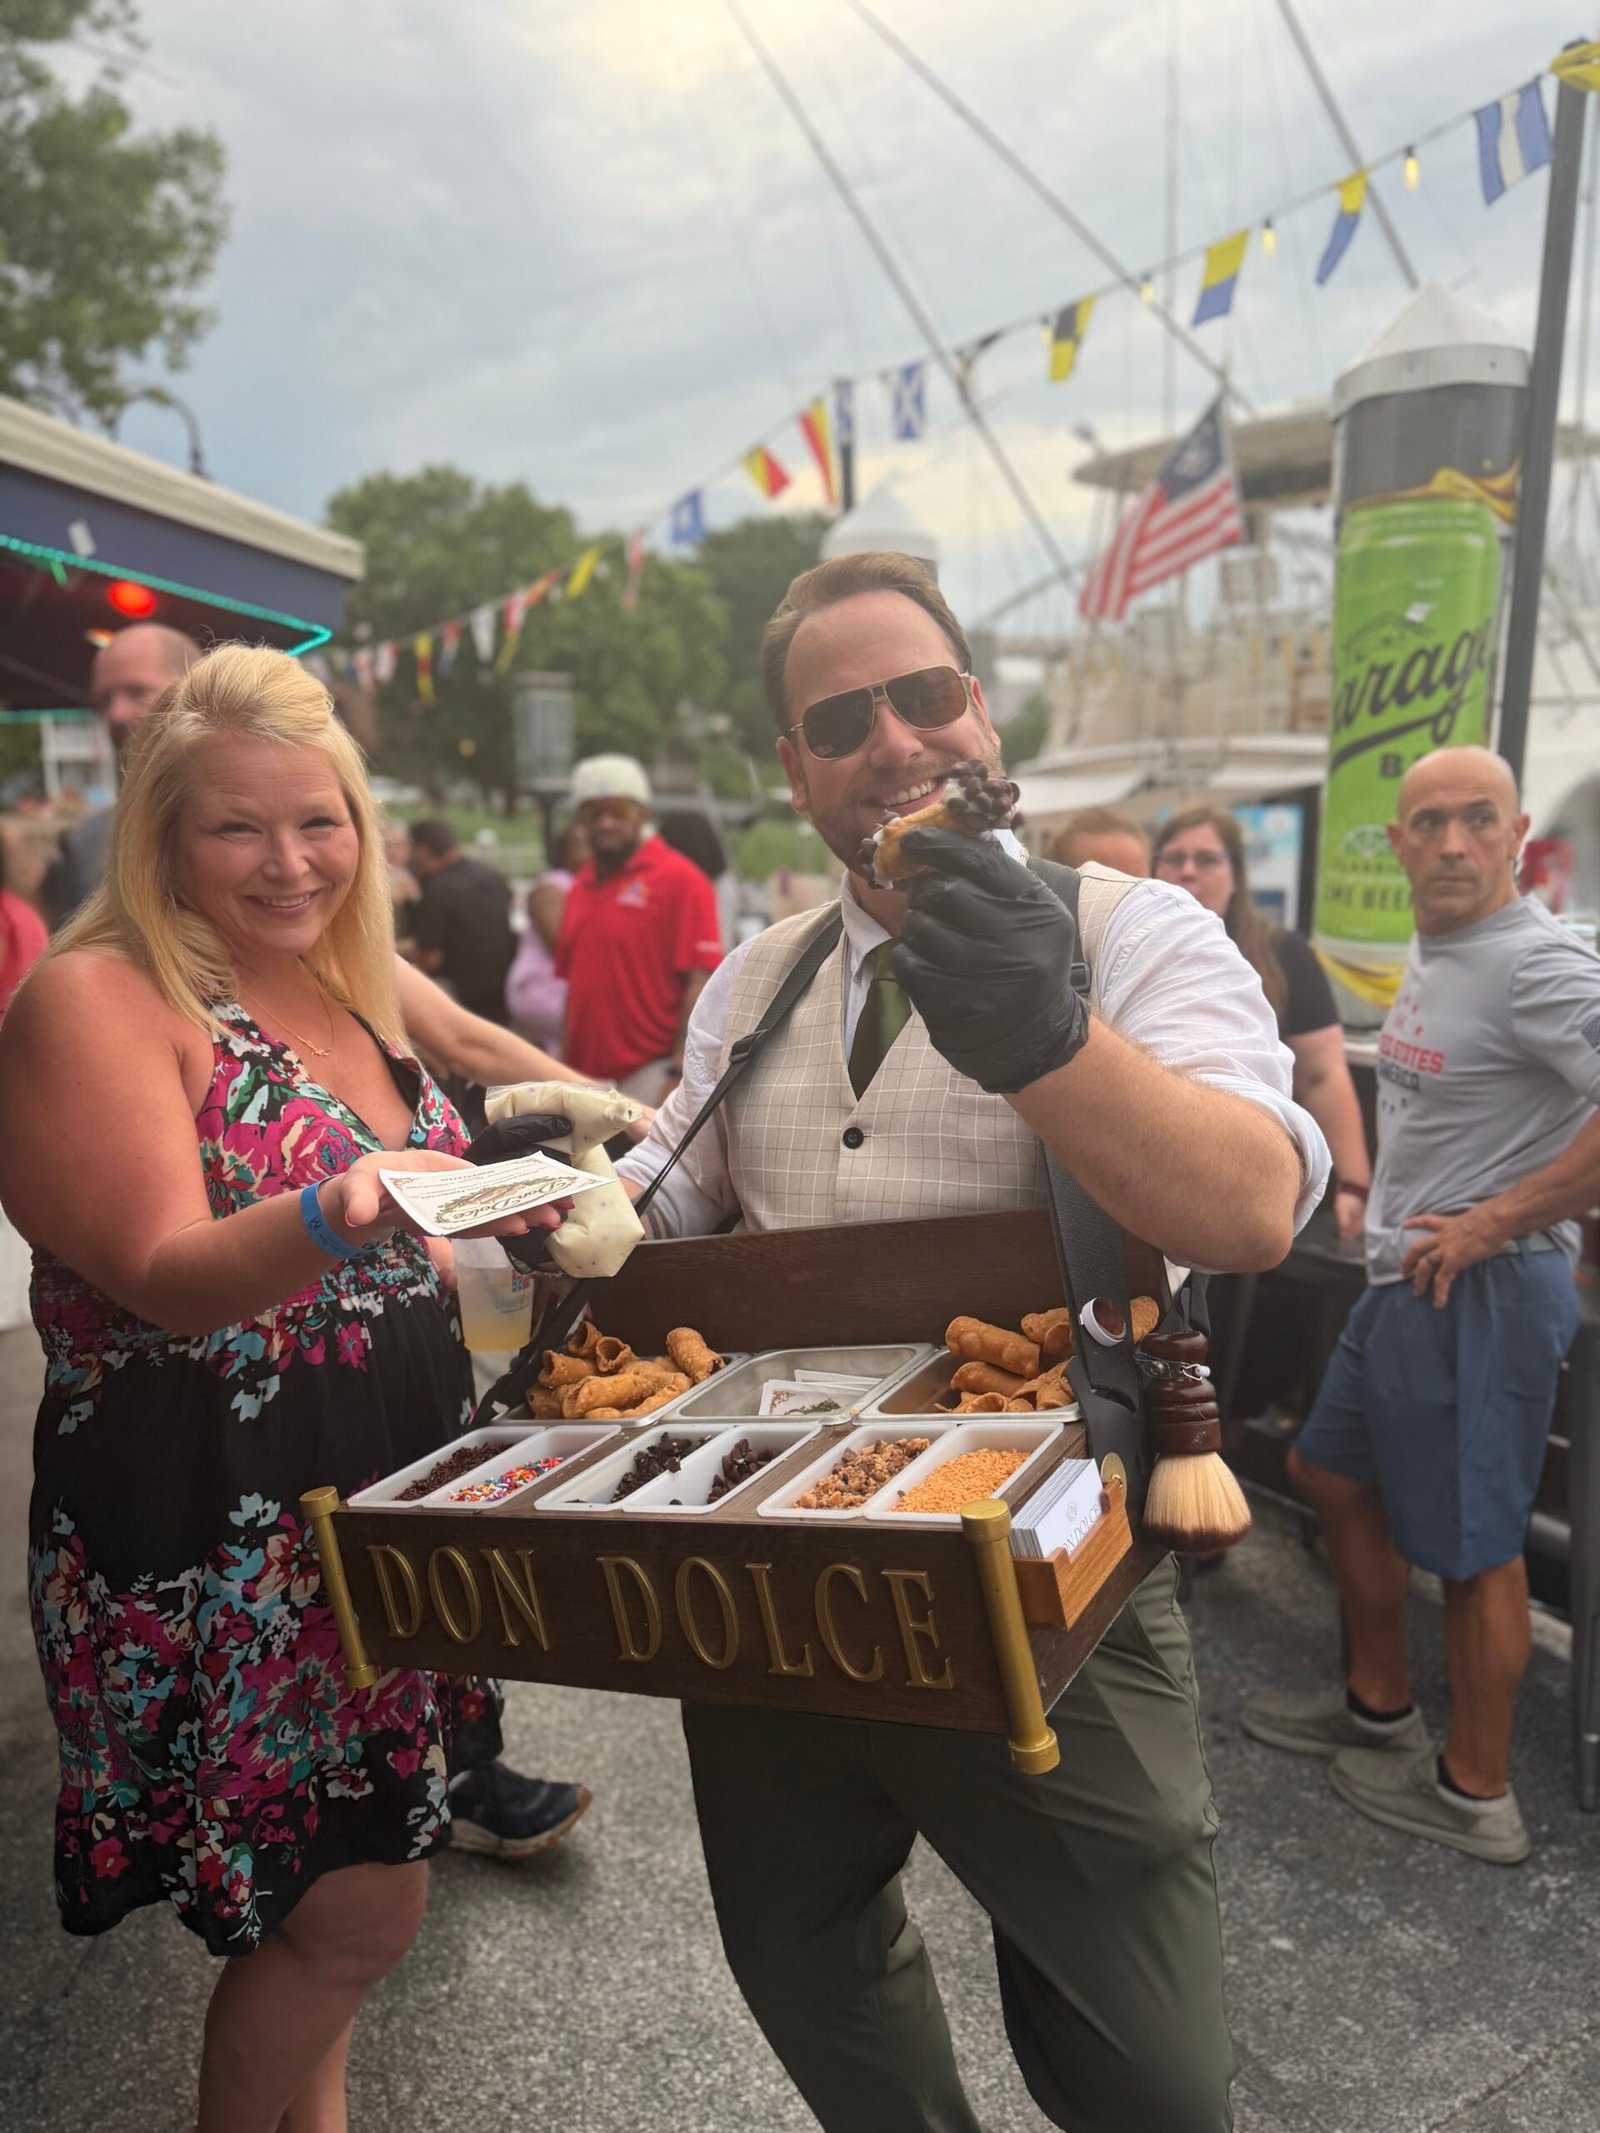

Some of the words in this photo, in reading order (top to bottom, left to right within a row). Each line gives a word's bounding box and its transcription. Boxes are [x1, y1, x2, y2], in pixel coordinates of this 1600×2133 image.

[453, 1197, 524, 1220] Dolce
[365, 1543, 552, 1653] DON
[596, 1553, 957, 1691] DOLCE
